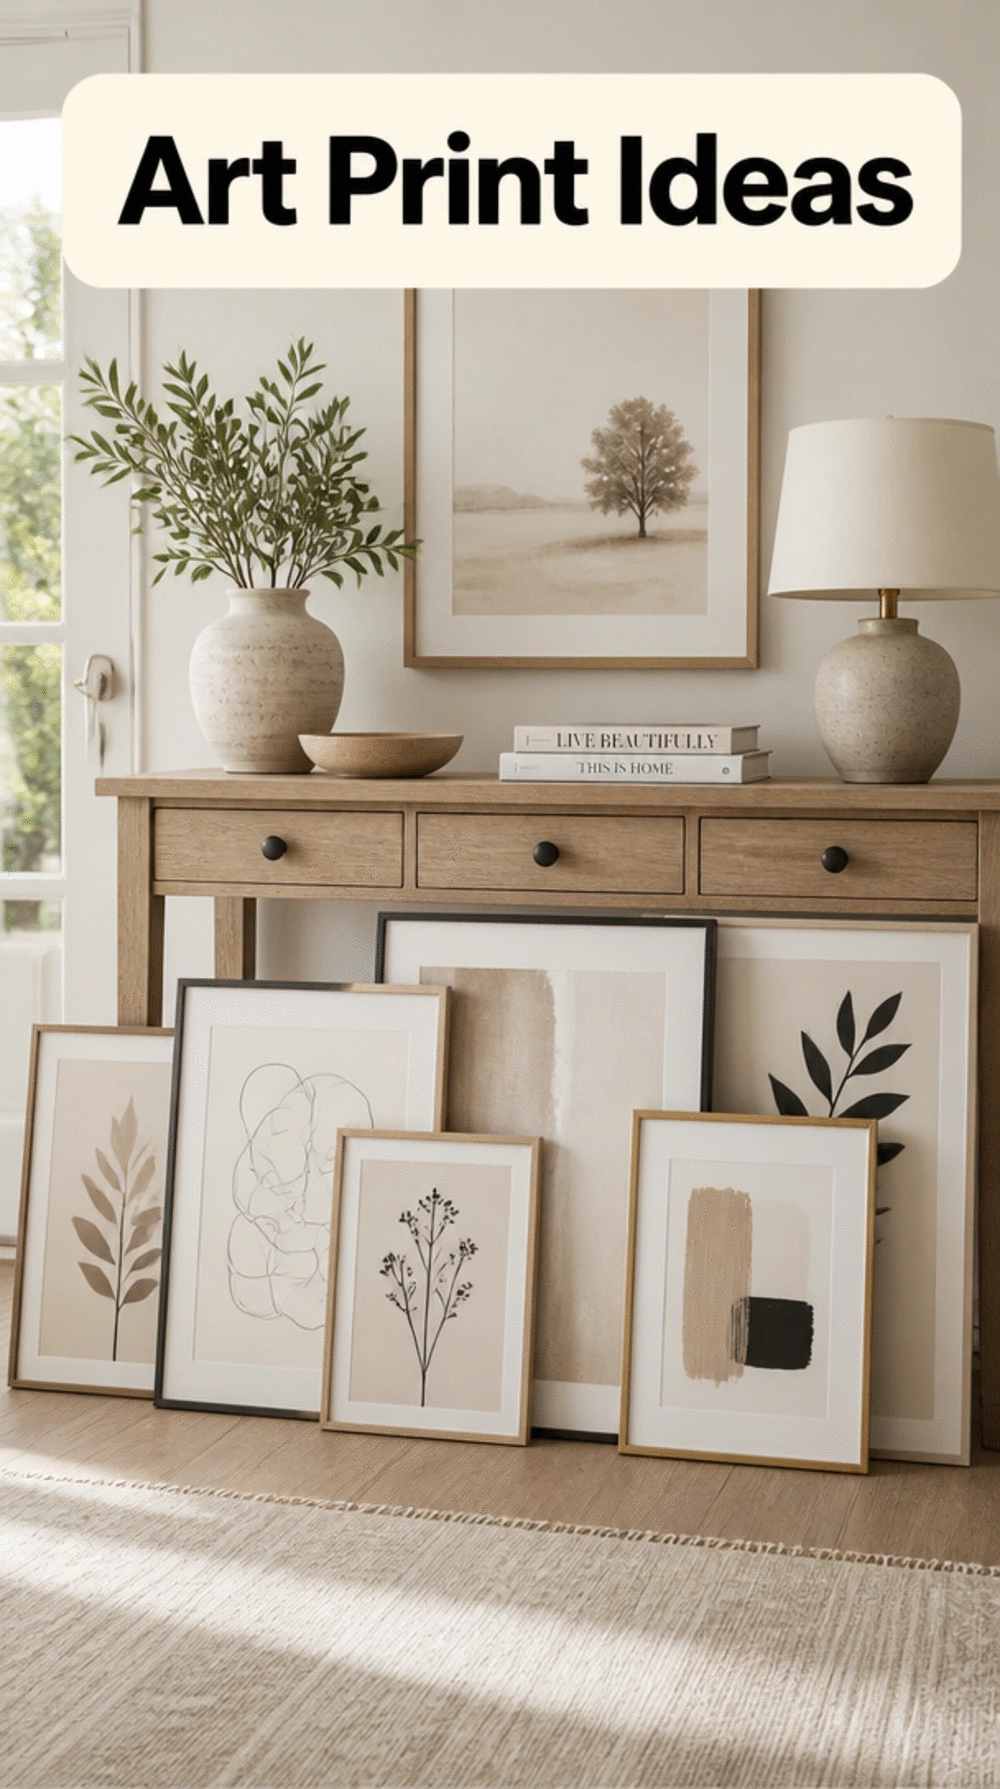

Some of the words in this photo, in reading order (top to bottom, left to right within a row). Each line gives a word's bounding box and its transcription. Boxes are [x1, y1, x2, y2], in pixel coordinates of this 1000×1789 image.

[556, 732, 596, 749] LIVE
[600, 733, 718, 750] BEAUTIFULLY
[576, 761, 611, 774] THIS
[614, 762, 627, 774] IS
[630, 762, 673, 775] HOME
